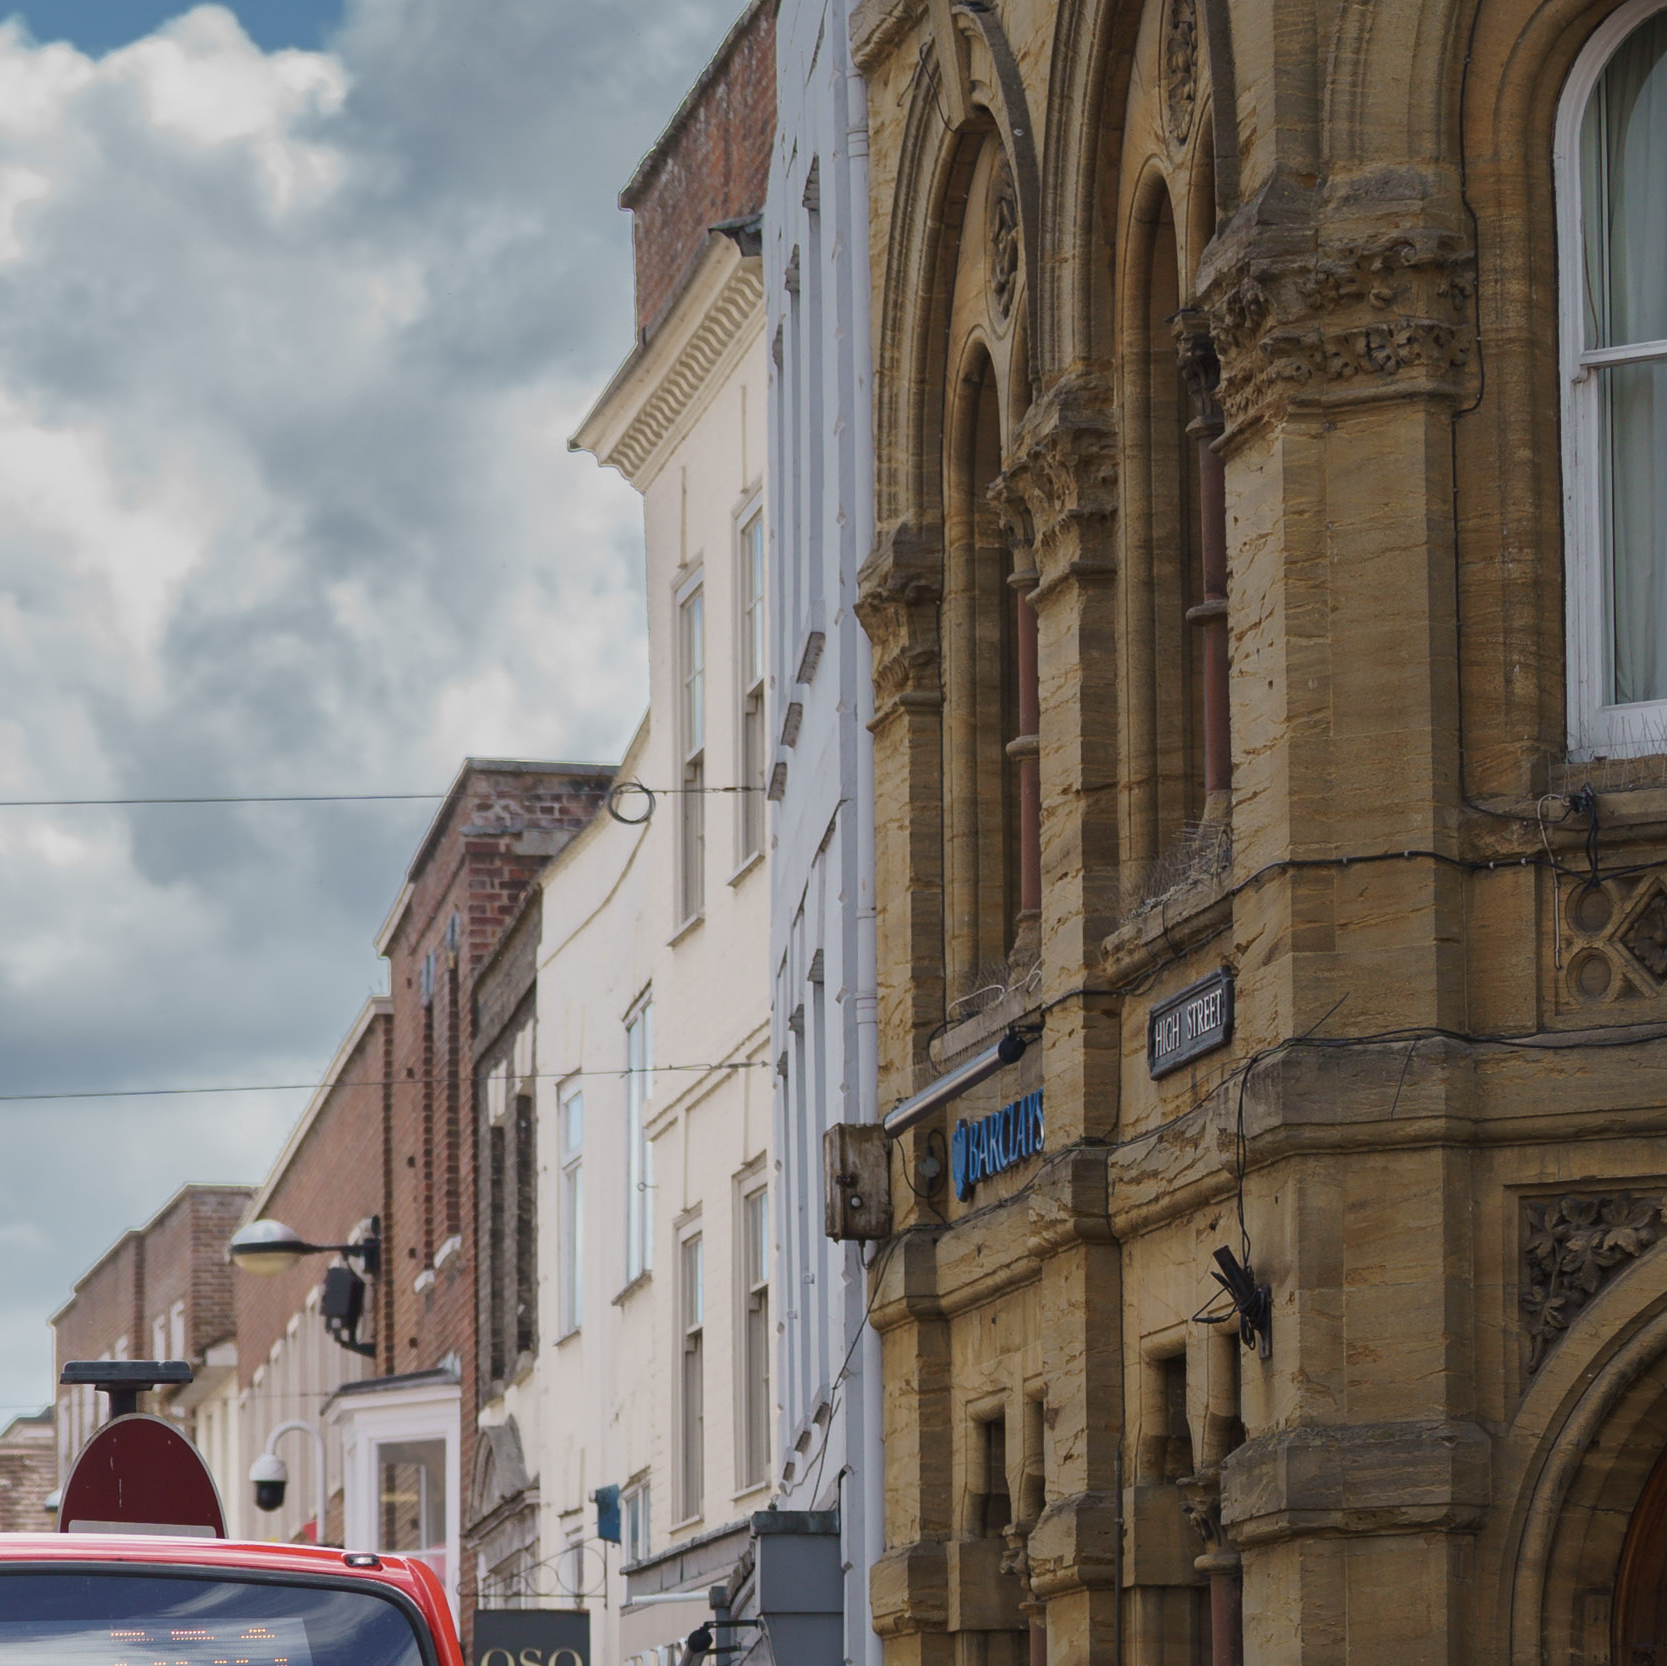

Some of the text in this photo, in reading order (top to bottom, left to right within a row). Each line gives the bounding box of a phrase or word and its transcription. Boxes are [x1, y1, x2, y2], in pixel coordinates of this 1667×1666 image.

[1154, 989, 1223, 1058] HIGH STREET
[969, 1086, 1045, 1184] BARCLAYS
